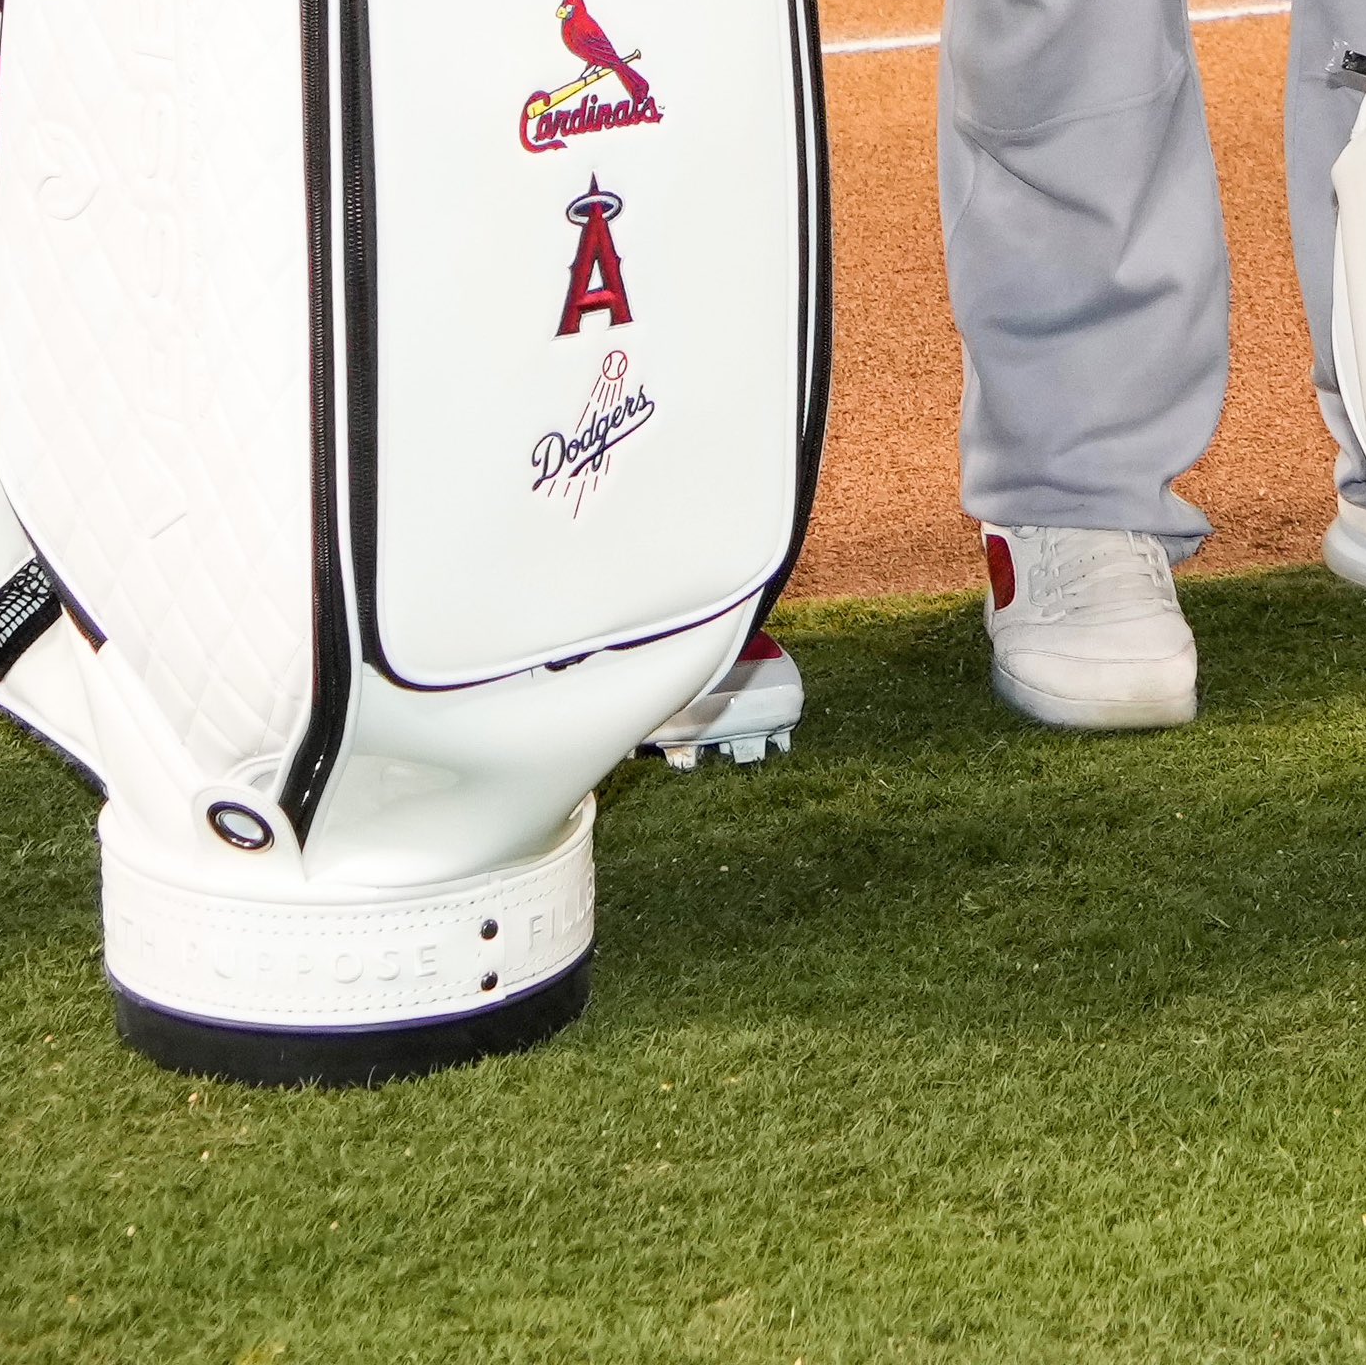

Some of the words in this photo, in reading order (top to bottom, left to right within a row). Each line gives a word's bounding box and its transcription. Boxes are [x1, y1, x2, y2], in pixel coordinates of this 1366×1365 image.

[519, 90, 664, 153] Cardinals
[555, 171, 635, 340] A
[531, 383, 656, 492] Dodgers
